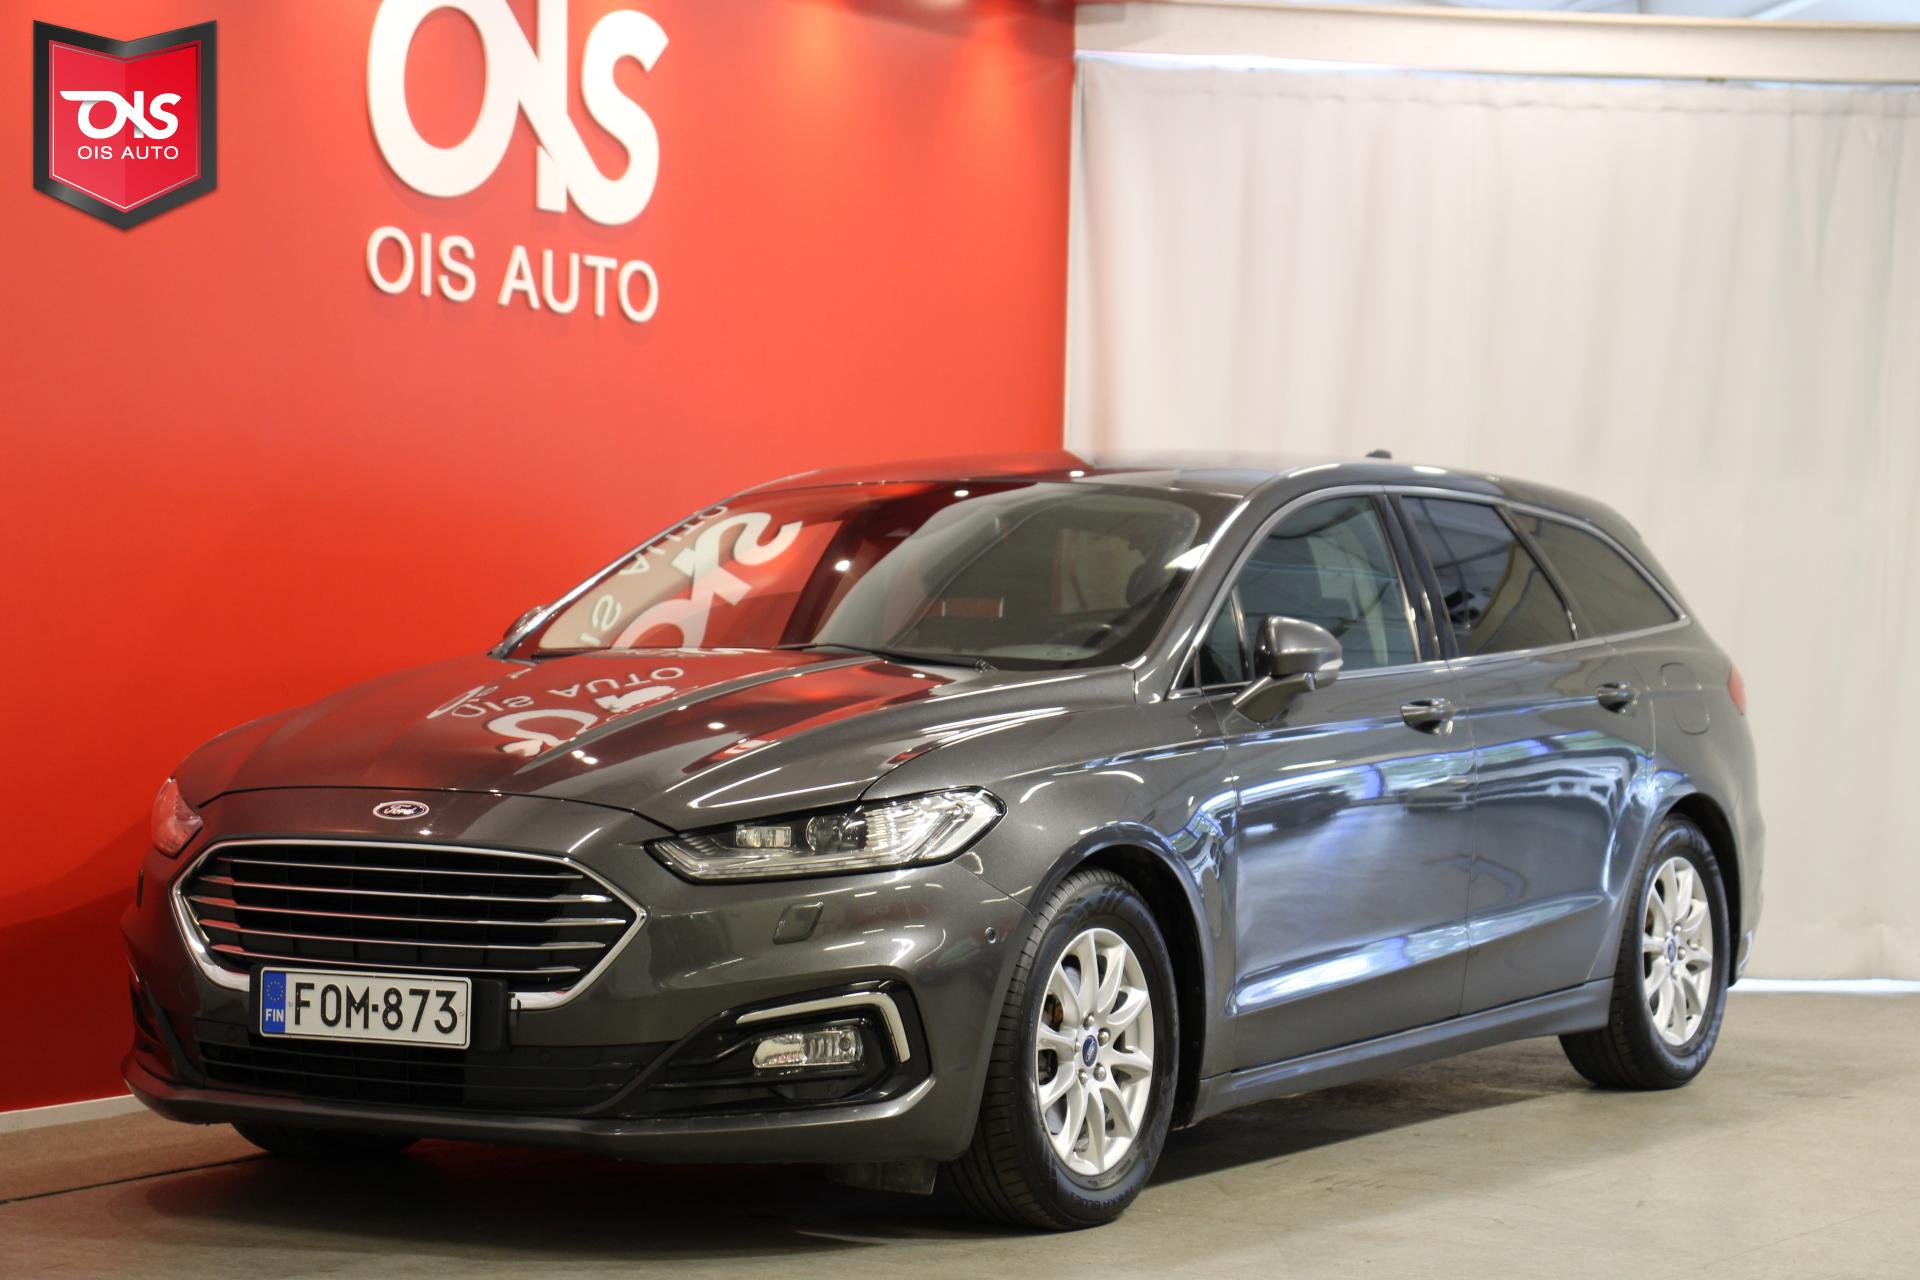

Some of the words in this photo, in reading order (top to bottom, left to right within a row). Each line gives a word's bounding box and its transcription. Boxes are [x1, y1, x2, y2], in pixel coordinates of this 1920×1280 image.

[366, 0, 669, 225] OIS
[366, 225, 477, 302] OIS
[497, 245, 659, 323] AUTO
[265, 1008, 284, 1023] FIN
[294, 982, 459, 1034] FOM-873
